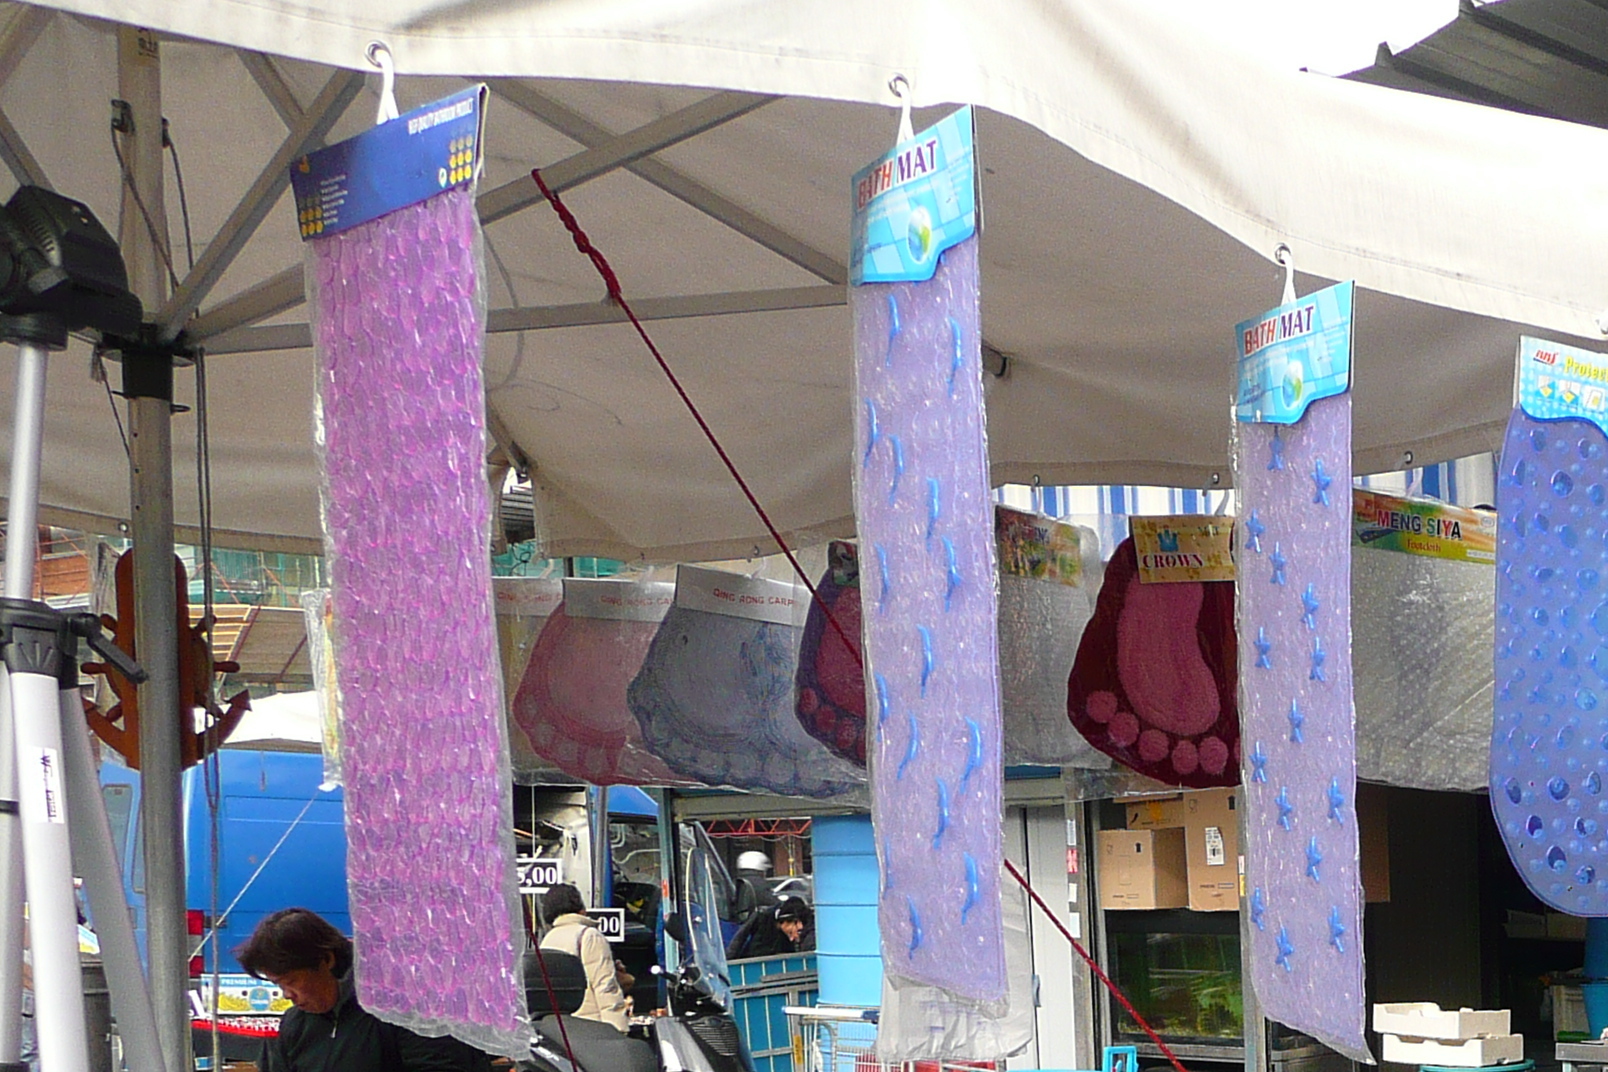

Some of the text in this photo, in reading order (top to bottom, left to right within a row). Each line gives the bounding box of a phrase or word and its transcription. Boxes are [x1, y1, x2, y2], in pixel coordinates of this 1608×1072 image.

[857, 139, 937, 211] BATH MAT
[1244, 305, 1314, 356] BATH MAT
[1377, 510, 1462, 541] MENG SIYA
[1142, 553, 1204, 569] CROWN
